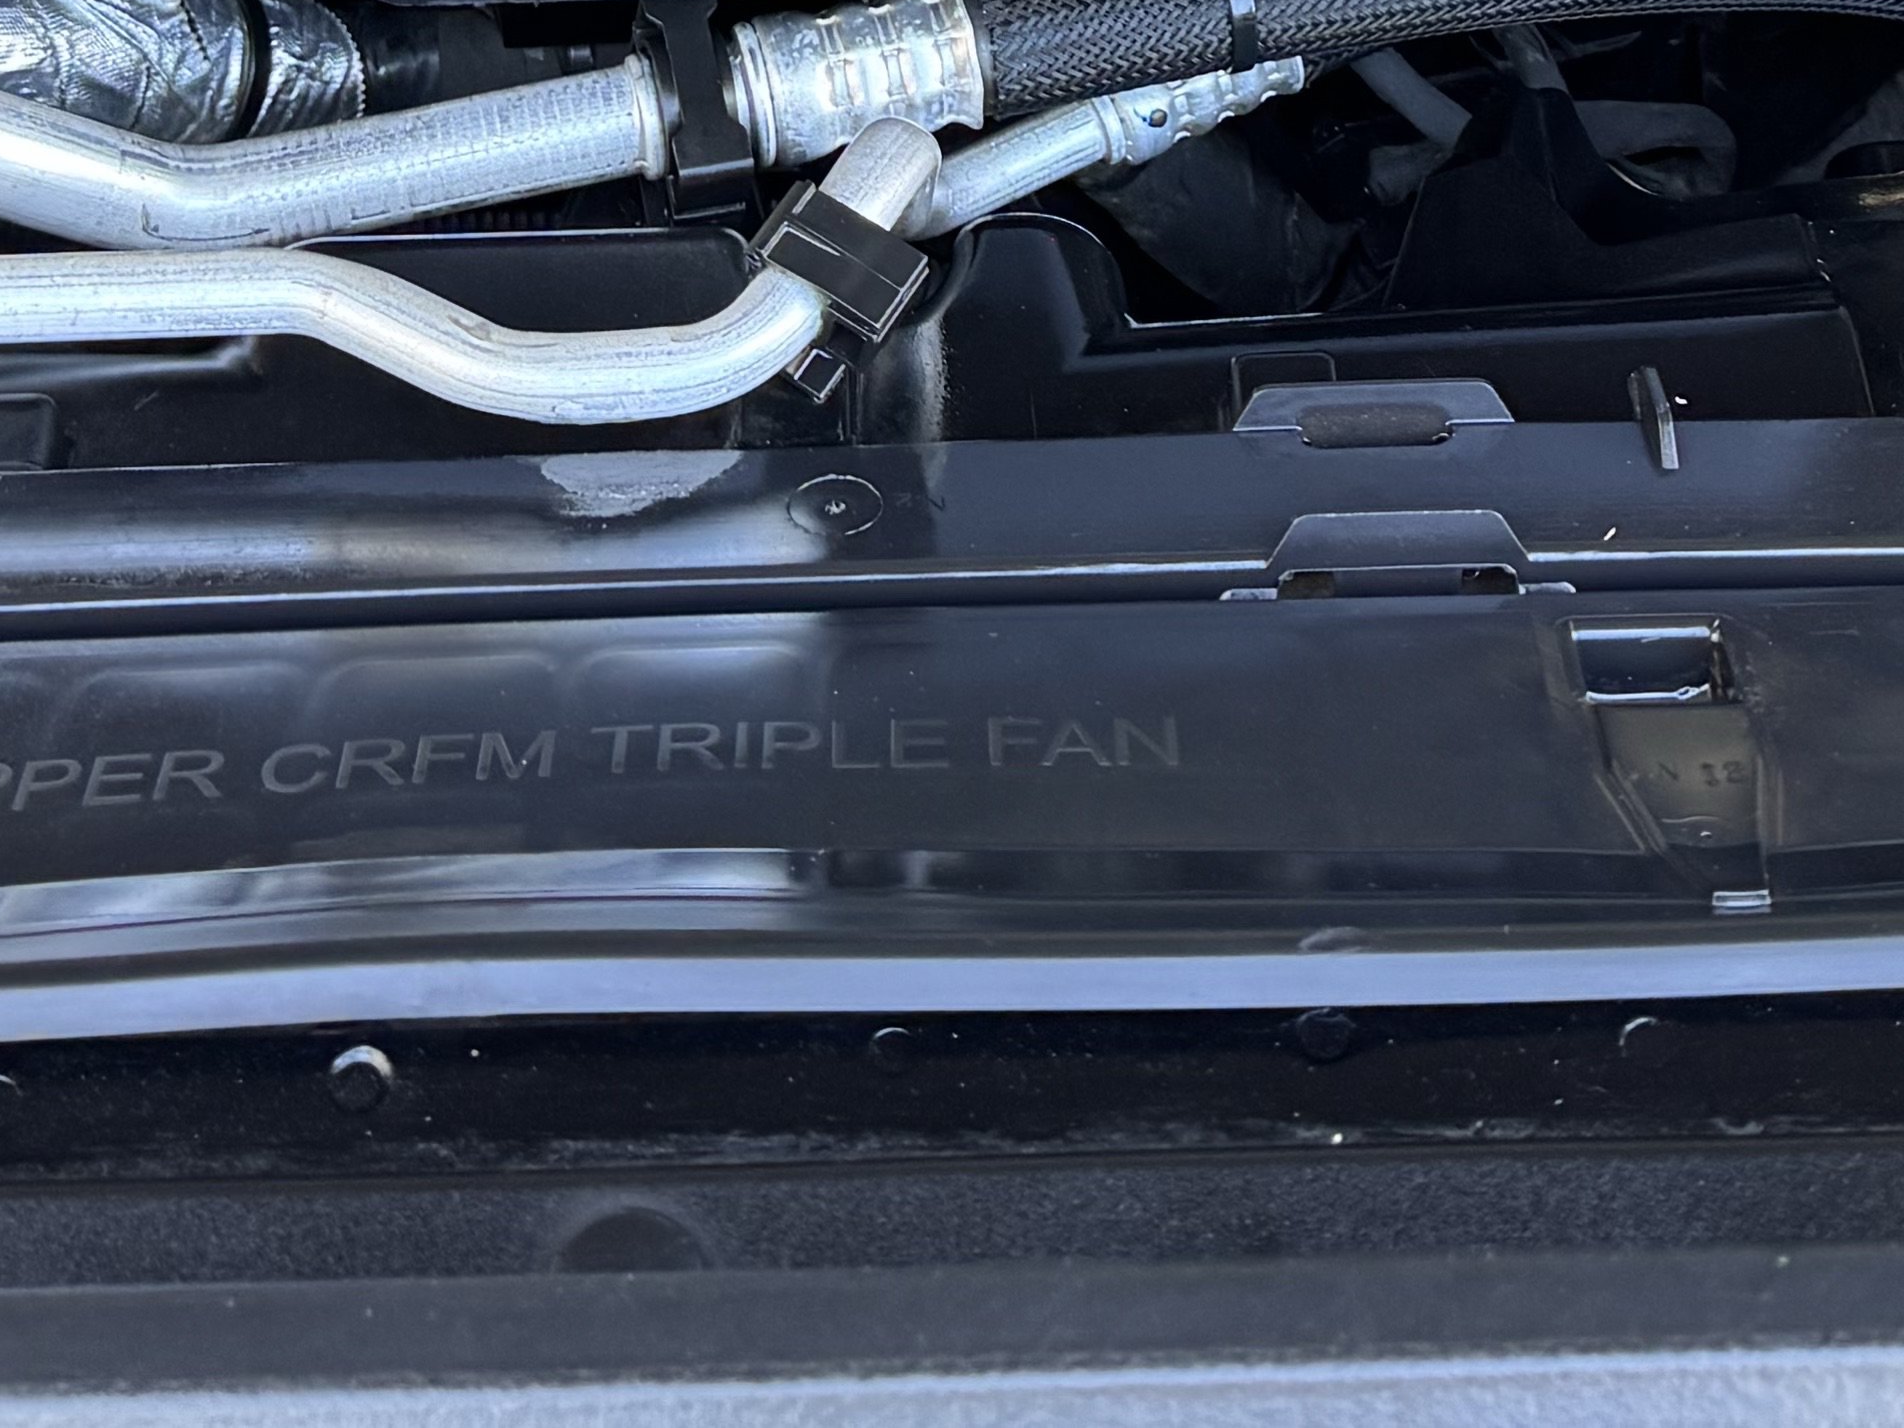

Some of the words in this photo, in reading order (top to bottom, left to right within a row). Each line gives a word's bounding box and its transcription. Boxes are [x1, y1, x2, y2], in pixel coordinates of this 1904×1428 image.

[261, 727, 552, 794] CRFM
[593, 717, 950, 773] TRIPLE
[984, 716, 1183, 768] FAN
